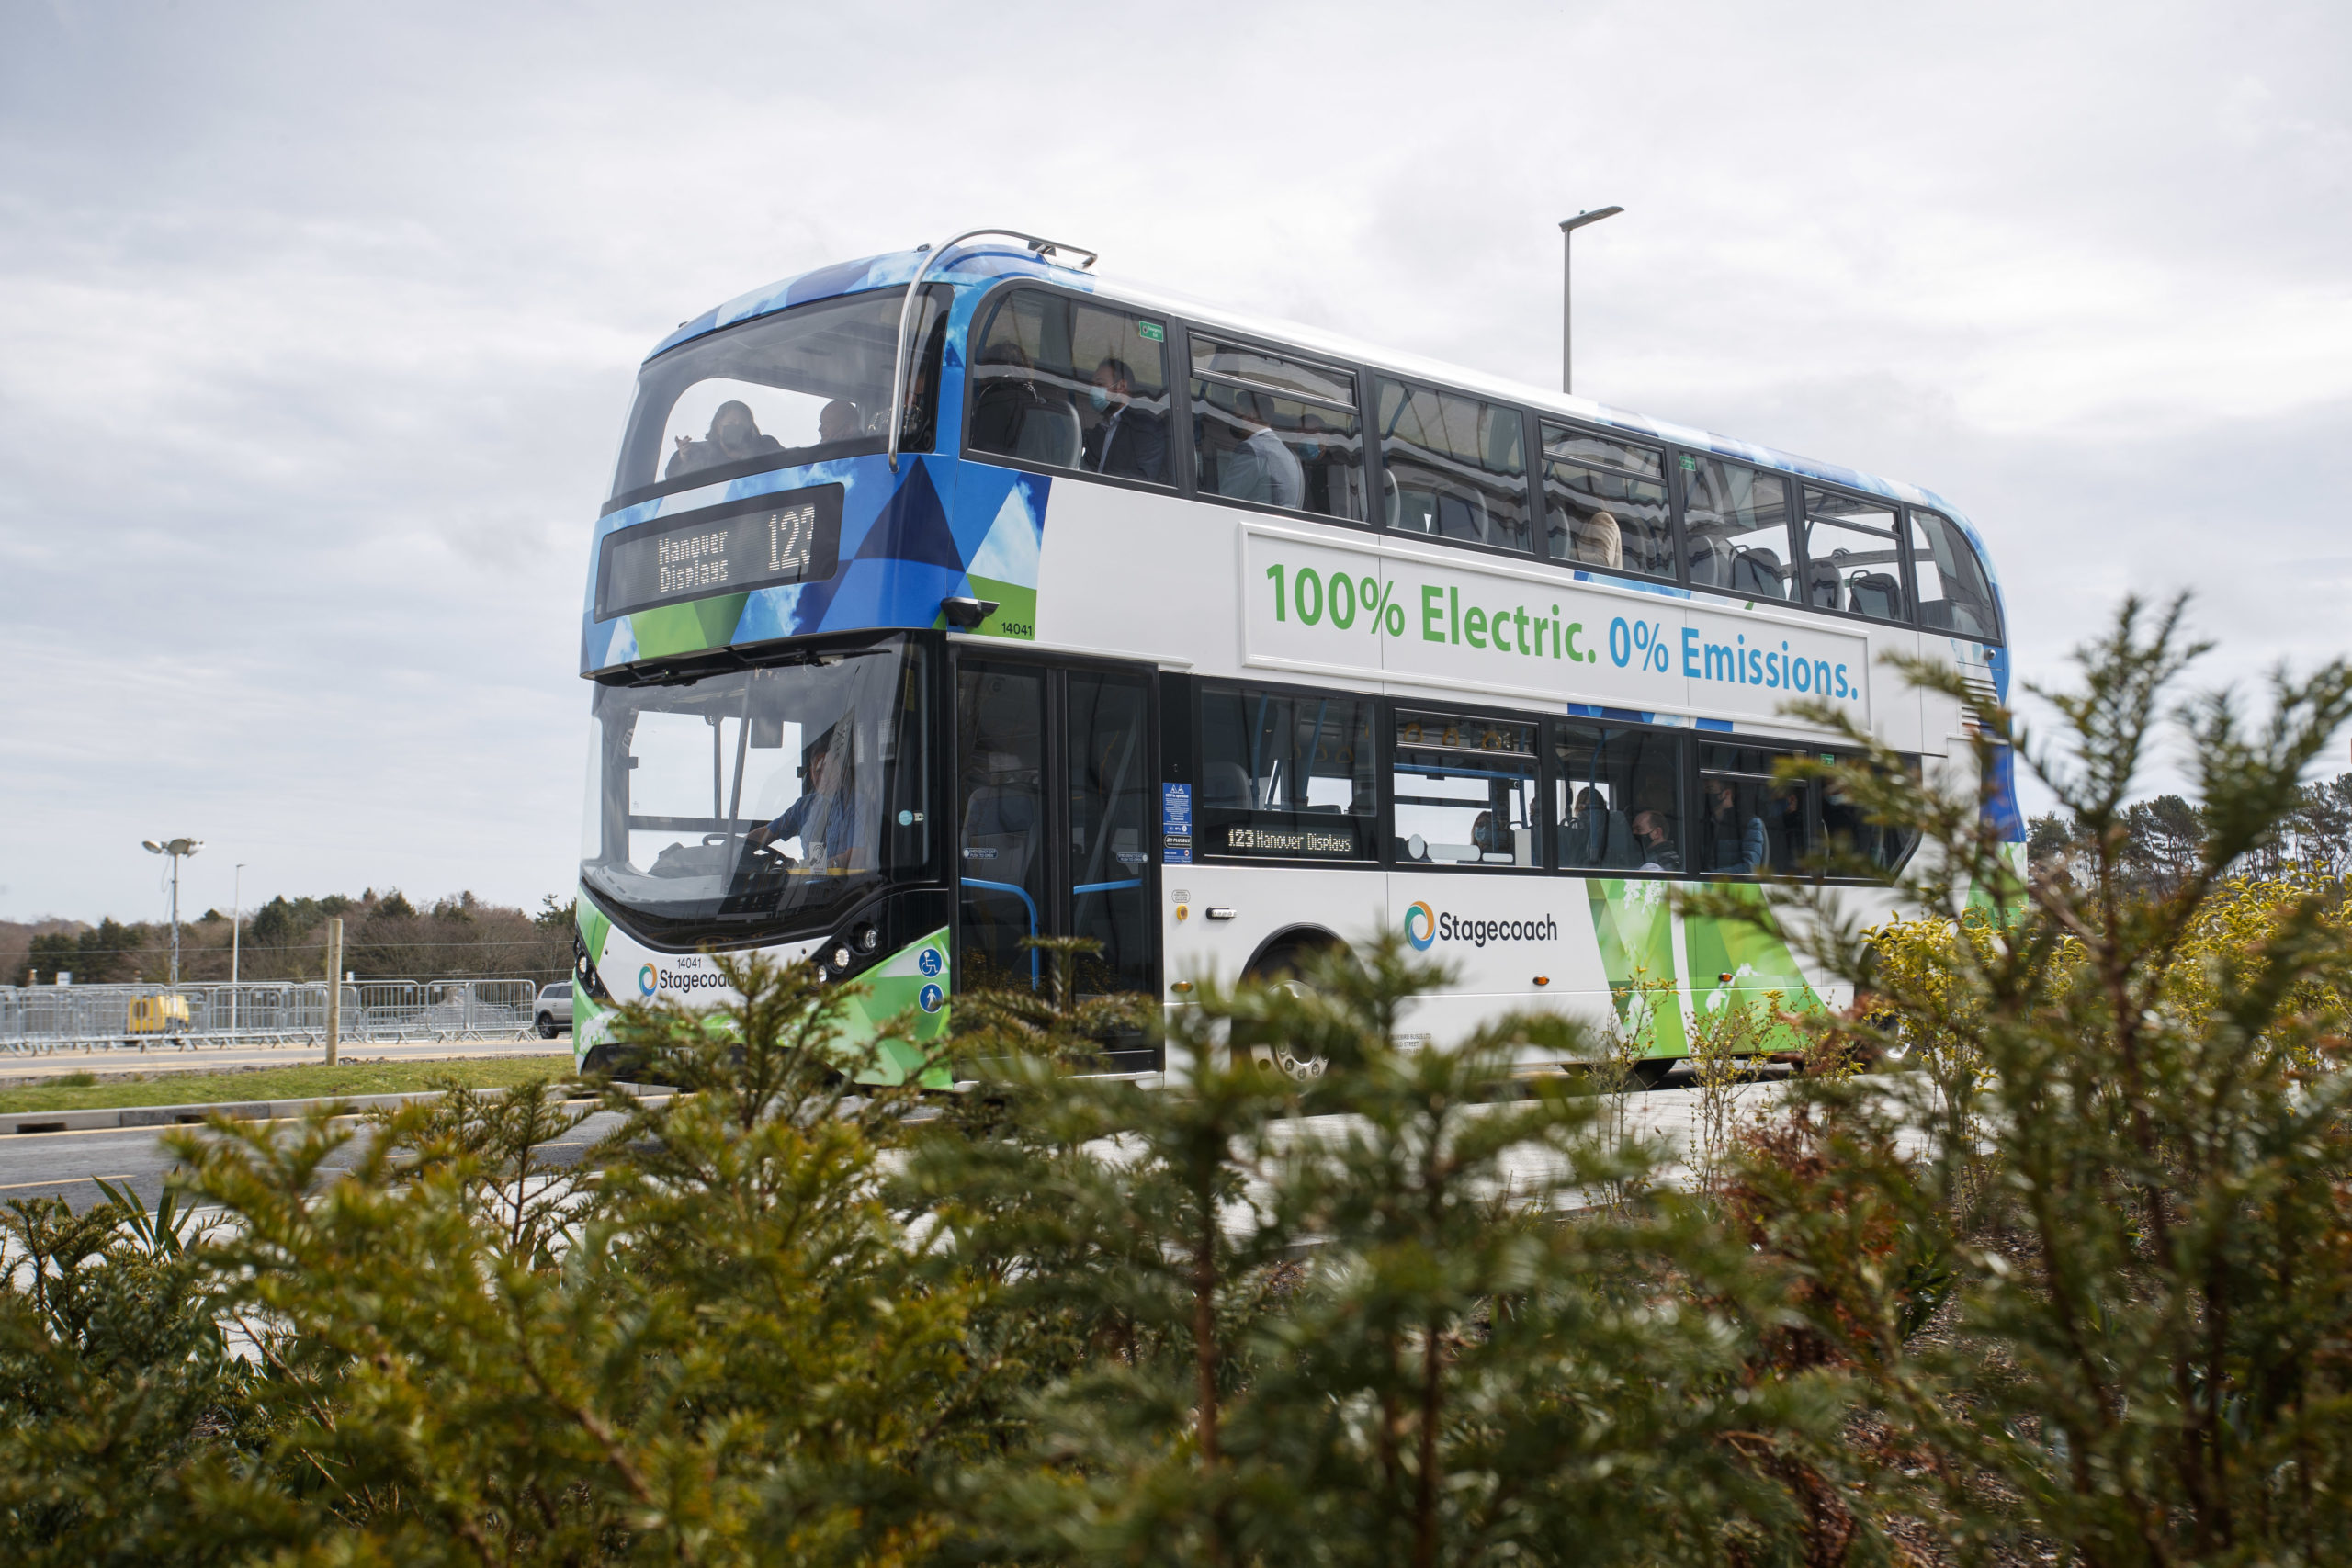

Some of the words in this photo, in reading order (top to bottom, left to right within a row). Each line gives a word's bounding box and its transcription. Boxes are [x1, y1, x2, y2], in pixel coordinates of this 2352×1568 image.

[658, 531, 729, 565] Hanover
[768, 507, 815, 570] 123
[660, 559, 729, 592] Displays
[1001, 622, 1032, 636] 14041
[1266, 563, 1406, 637] 100%
[1421, 584, 1596, 664] Electric.
[1609, 617, 1669, 673] 0%
[1681, 626, 1859, 701] Emissions.
[1228, 829, 1254, 847] 123
[1257, 830, 1304, 849] Hanover
[1307, 832, 1351, 852] Displays
[1439, 911, 1558, 948] Stagecoach
[677, 957, 701, 968] 14041
